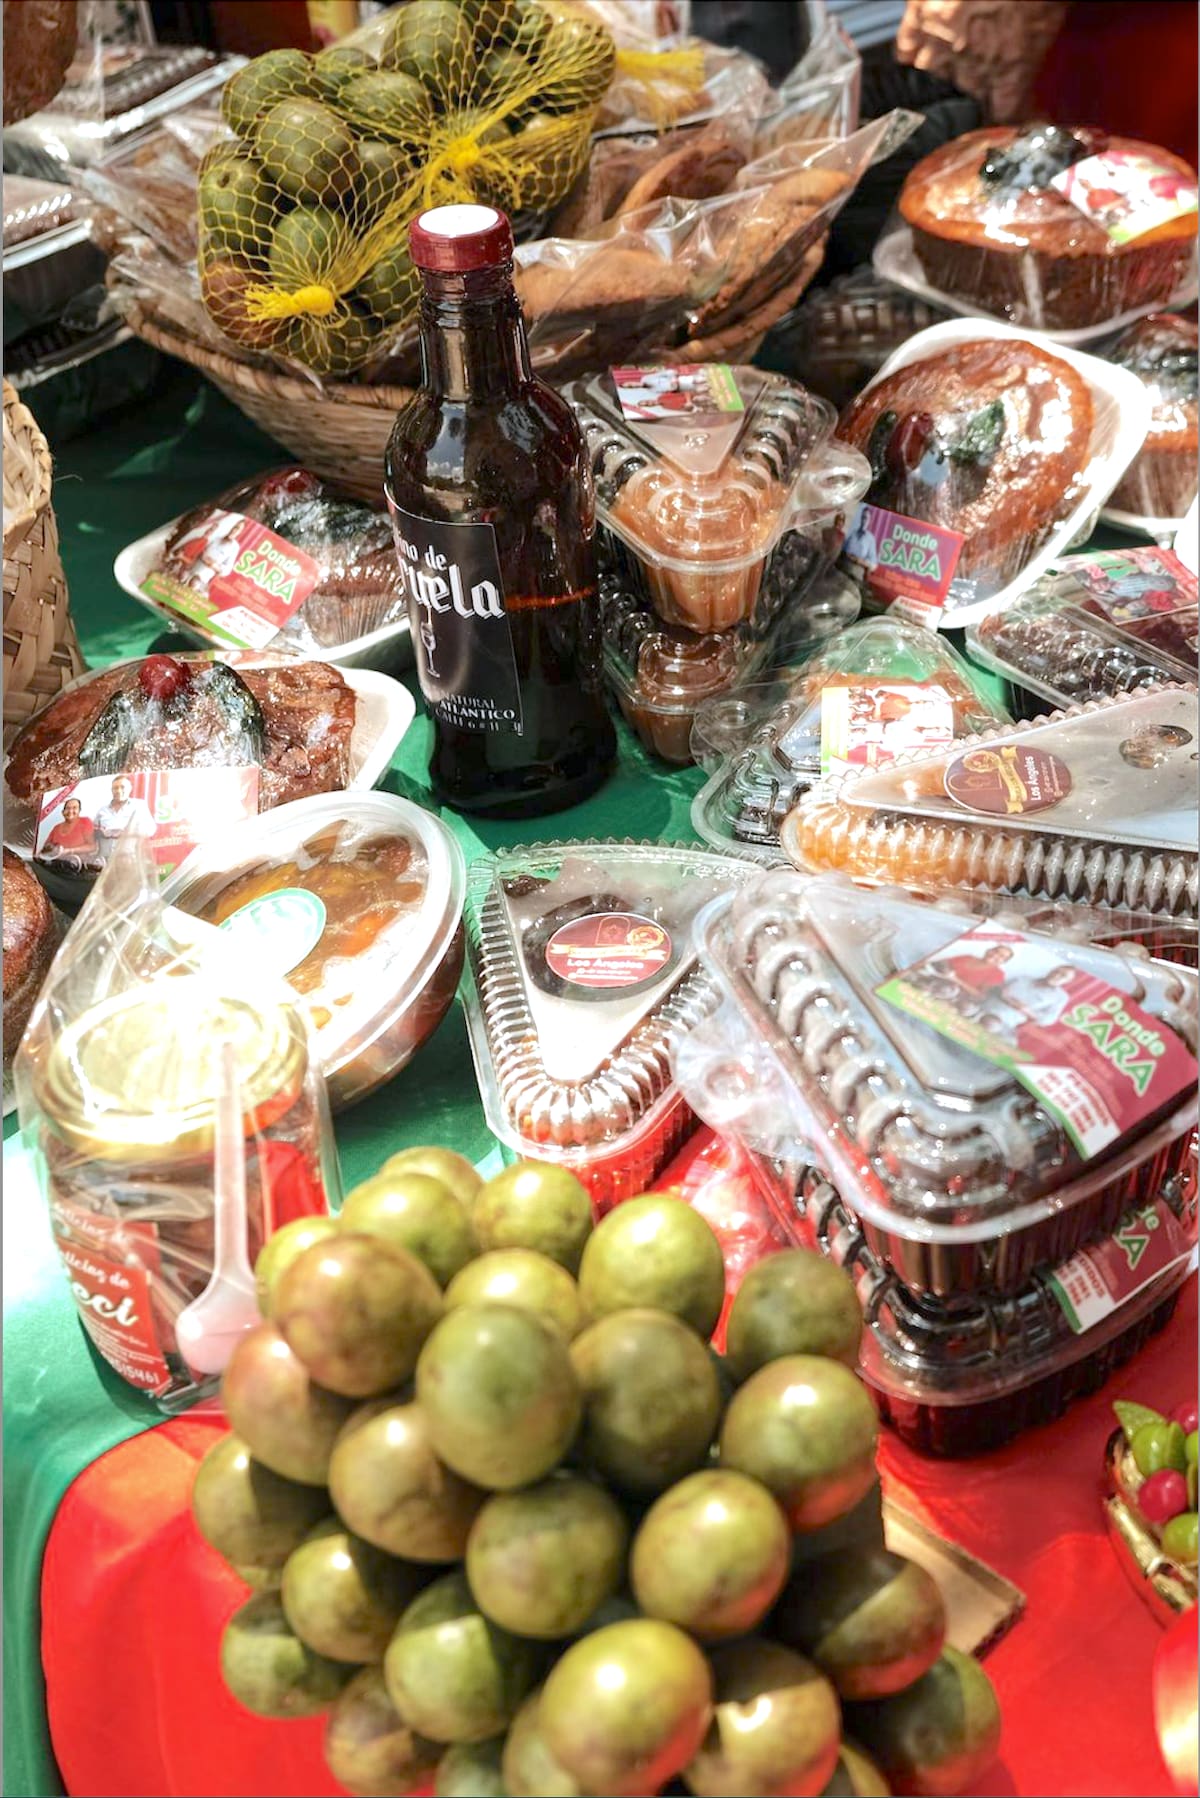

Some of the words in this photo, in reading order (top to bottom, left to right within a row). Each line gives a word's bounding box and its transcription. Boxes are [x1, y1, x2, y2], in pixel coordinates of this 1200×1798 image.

[399, 538, 419, 562] no
[424, 545, 447, 571] de
[892, 524, 938, 551] Donde
[258, 541, 301, 576] Donde
[880, 540, 941, 581] SARA
[235, 550, 297, 604] SARA
[440, 700, 515, 720] ATLANTICO
[1031, 787, 1042, 801] Los
[1101, 996, 1165, 1056] Donde
[1061, 1003, 1156, 1098] SARA
[109, 1271, 130, 1290] de
[72, 1281, 140, 1327] eci
